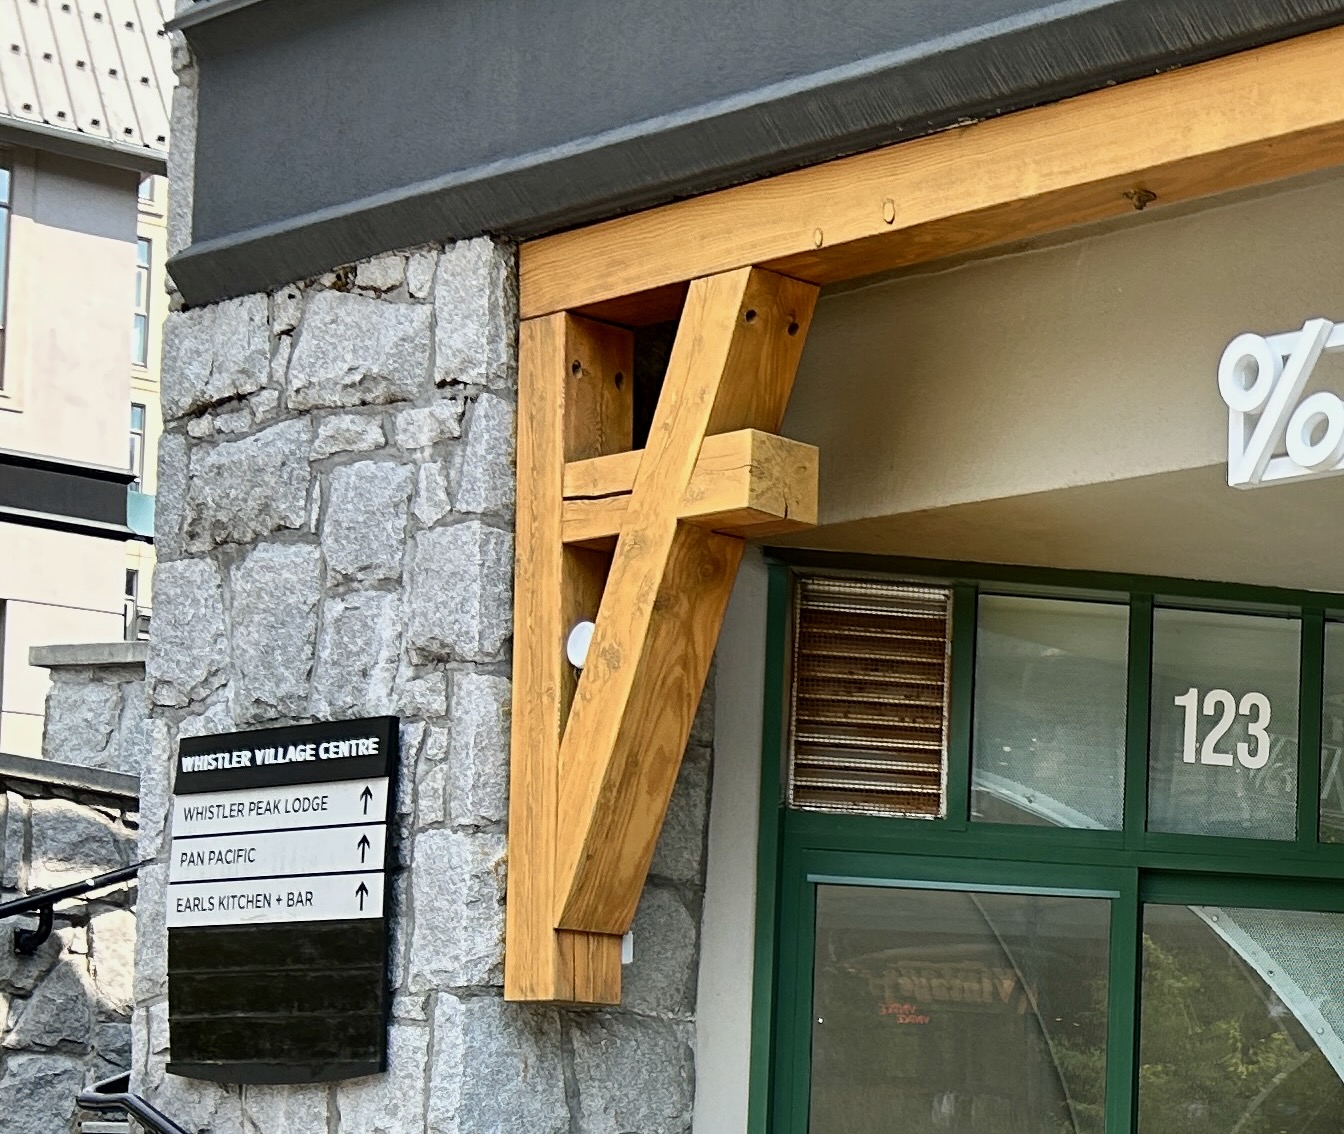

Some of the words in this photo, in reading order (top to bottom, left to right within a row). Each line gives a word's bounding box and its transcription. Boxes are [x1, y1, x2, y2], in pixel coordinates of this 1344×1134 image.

[1174, 687, 1272, 769] 123
[181, 749, 252, 774] WHISTLER
[254, 743, 316, 766] VILLAGE
[318, 737, 380, 761] CENTRE
[182, 798, 245, 822] WHISTLER
[248, 798, 282, 817] PEAK
[284, 795, 329, 814] LODGE
[180, 849, 205, 867] PAN
[208, 847, 257, 865] PACIFIC
[176, 896, 215, 914] EARLS
[217, 893, 272, 911] KITCHEN
[276, 896, 284, 907] +
[286, 891, 314, 909] BAR
